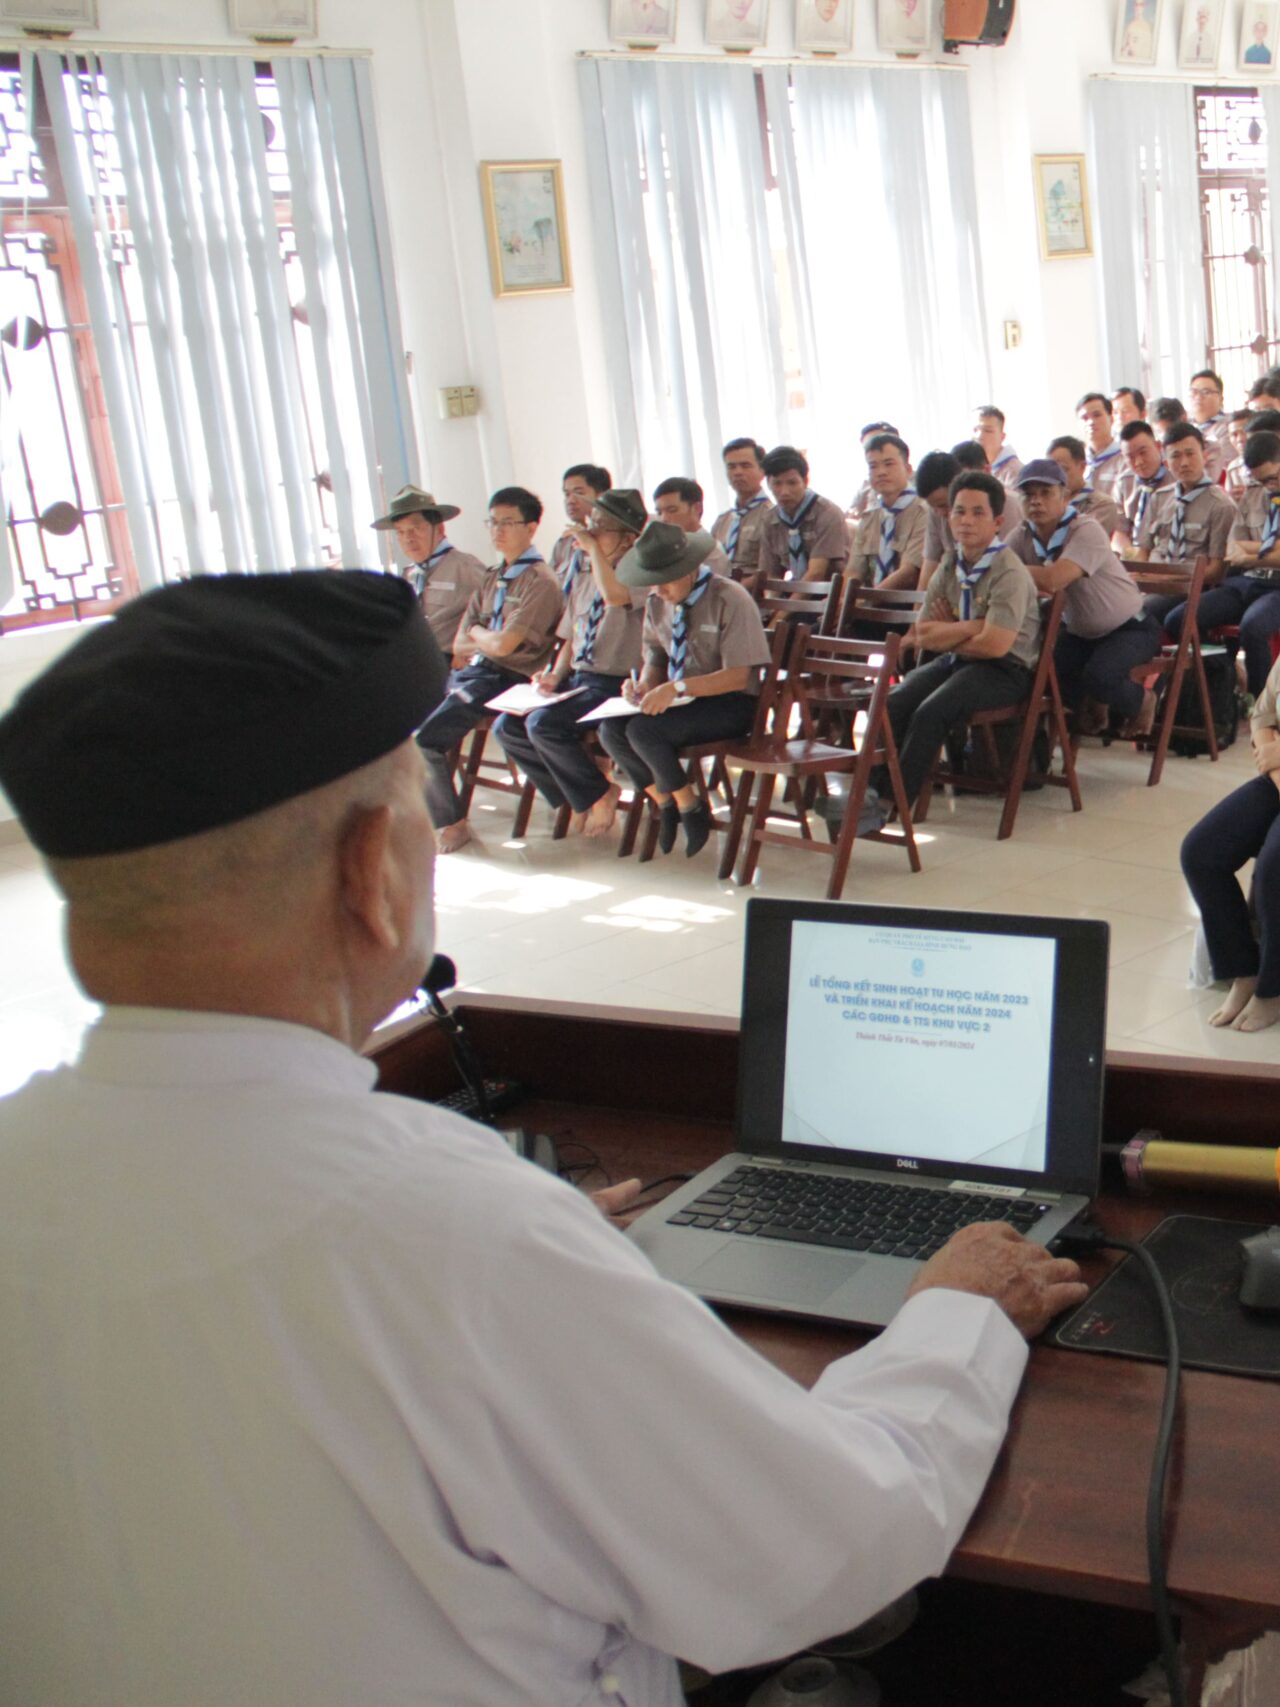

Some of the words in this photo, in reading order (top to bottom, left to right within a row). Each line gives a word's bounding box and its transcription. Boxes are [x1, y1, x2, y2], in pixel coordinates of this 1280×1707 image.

[822, 976, 851, 990] TỔNG
[853, 979, 871, 992] KẾT
[873, 983, 897, 994] SINH
[900, 985, 929, 998] HOẠT
[946, 989, 972, 1002] HỌC
[974, 990, 1000, 1003] NĂM
[1002, 993, 1029, 1005] 2023
[871, 998, 897, 1009] KHAI
[914, 1001, 955, 1014] HOẠCH
[957, 1003, 981, 1016] NĂM
[985, 1007, 1012, 1019] 2024
[842, 1009, 867, 1021] CÁC
[913, 1015, 930, 1027] TTS
[932, 1017, 954, 1029] KHU
[956, 1020, 981, 1033] VỰC
[983, 1022, 990, 1032] 2
[896, 1158, 919, 1169] DELL
